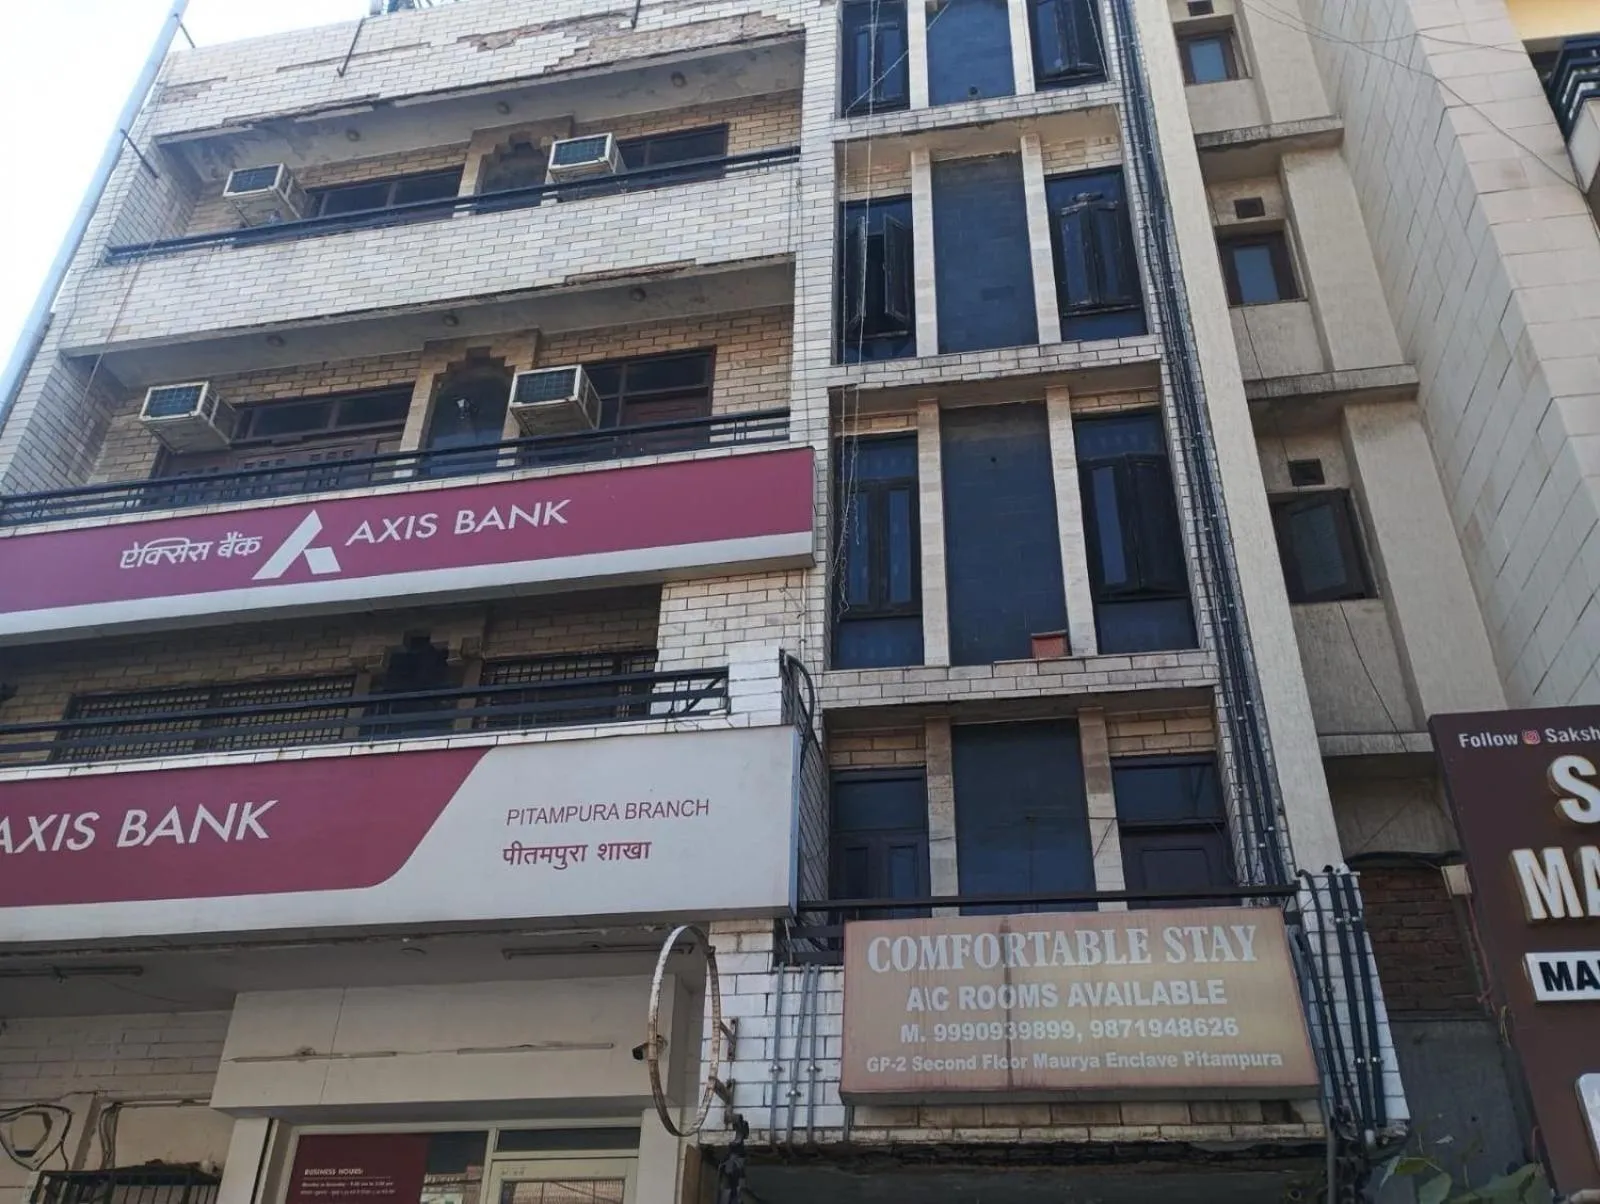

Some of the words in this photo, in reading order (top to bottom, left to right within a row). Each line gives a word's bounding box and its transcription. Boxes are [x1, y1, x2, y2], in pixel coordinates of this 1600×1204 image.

[345, 513, 438, 546] AXIS
[454, 499, 571, 535] BANK
[217, 531, 263, 558] बैंक
[1458, 731, 1519, 748] Follow
[116, 799, 279, 848] BANK
[506, 803, 620, 826] PITAMPURA
[624, 798, 710, 820] BRANCH
[502, 840, 589, 870] पीतमपुरा
[596, 841, 653, 861] शाखा
[868, 928, 1152, 973] COMFORTABLE
[1162, 925, 1258, 964] STAY
[1539, 960, 1600, 991] MA
[958, 984, 1059, 1010] ROOMS
[1067, 979, 1228, 1007] AVAILABLE
[901, 1024, 926, 1043] M.
[934, 1020, 1084, 1043] 9990939899,
[1090, 1017, 1240, 1038] 9871948626
[866, 1056, 907, 1072] GP-2
[912, 1055, 977, 1071] Second
[982, 1053, 1029, 1070] Floor
[1033, 1052, 1099, 1072] Maurya
[1105, 1052, 1178, 1069] Enclave
[1182, 1051, 1283, 1070] Pitampura
